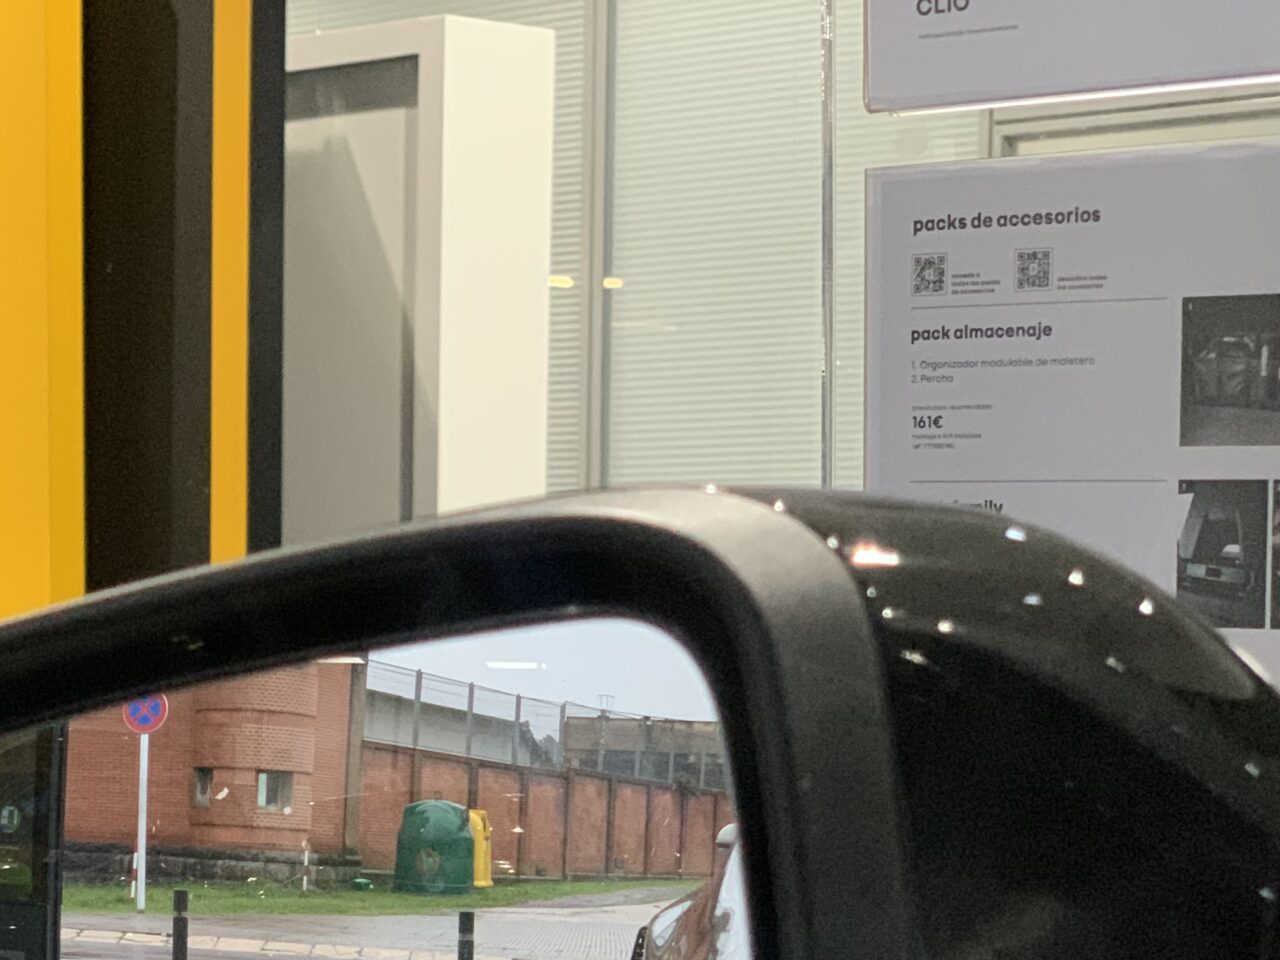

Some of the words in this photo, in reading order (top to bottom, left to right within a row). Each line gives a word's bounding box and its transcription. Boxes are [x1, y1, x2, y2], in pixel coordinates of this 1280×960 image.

[916, 0, 970, 16] CLIO
[913, 214, 967, 237] packs
[971, 212, 993, 229] de
[996, 206, 1101, 228] accesorios
[911, 325, 951, 344] pack
[954, 322, 1053, 341] almacenaje
[912, 415, 943, 429] 161€
